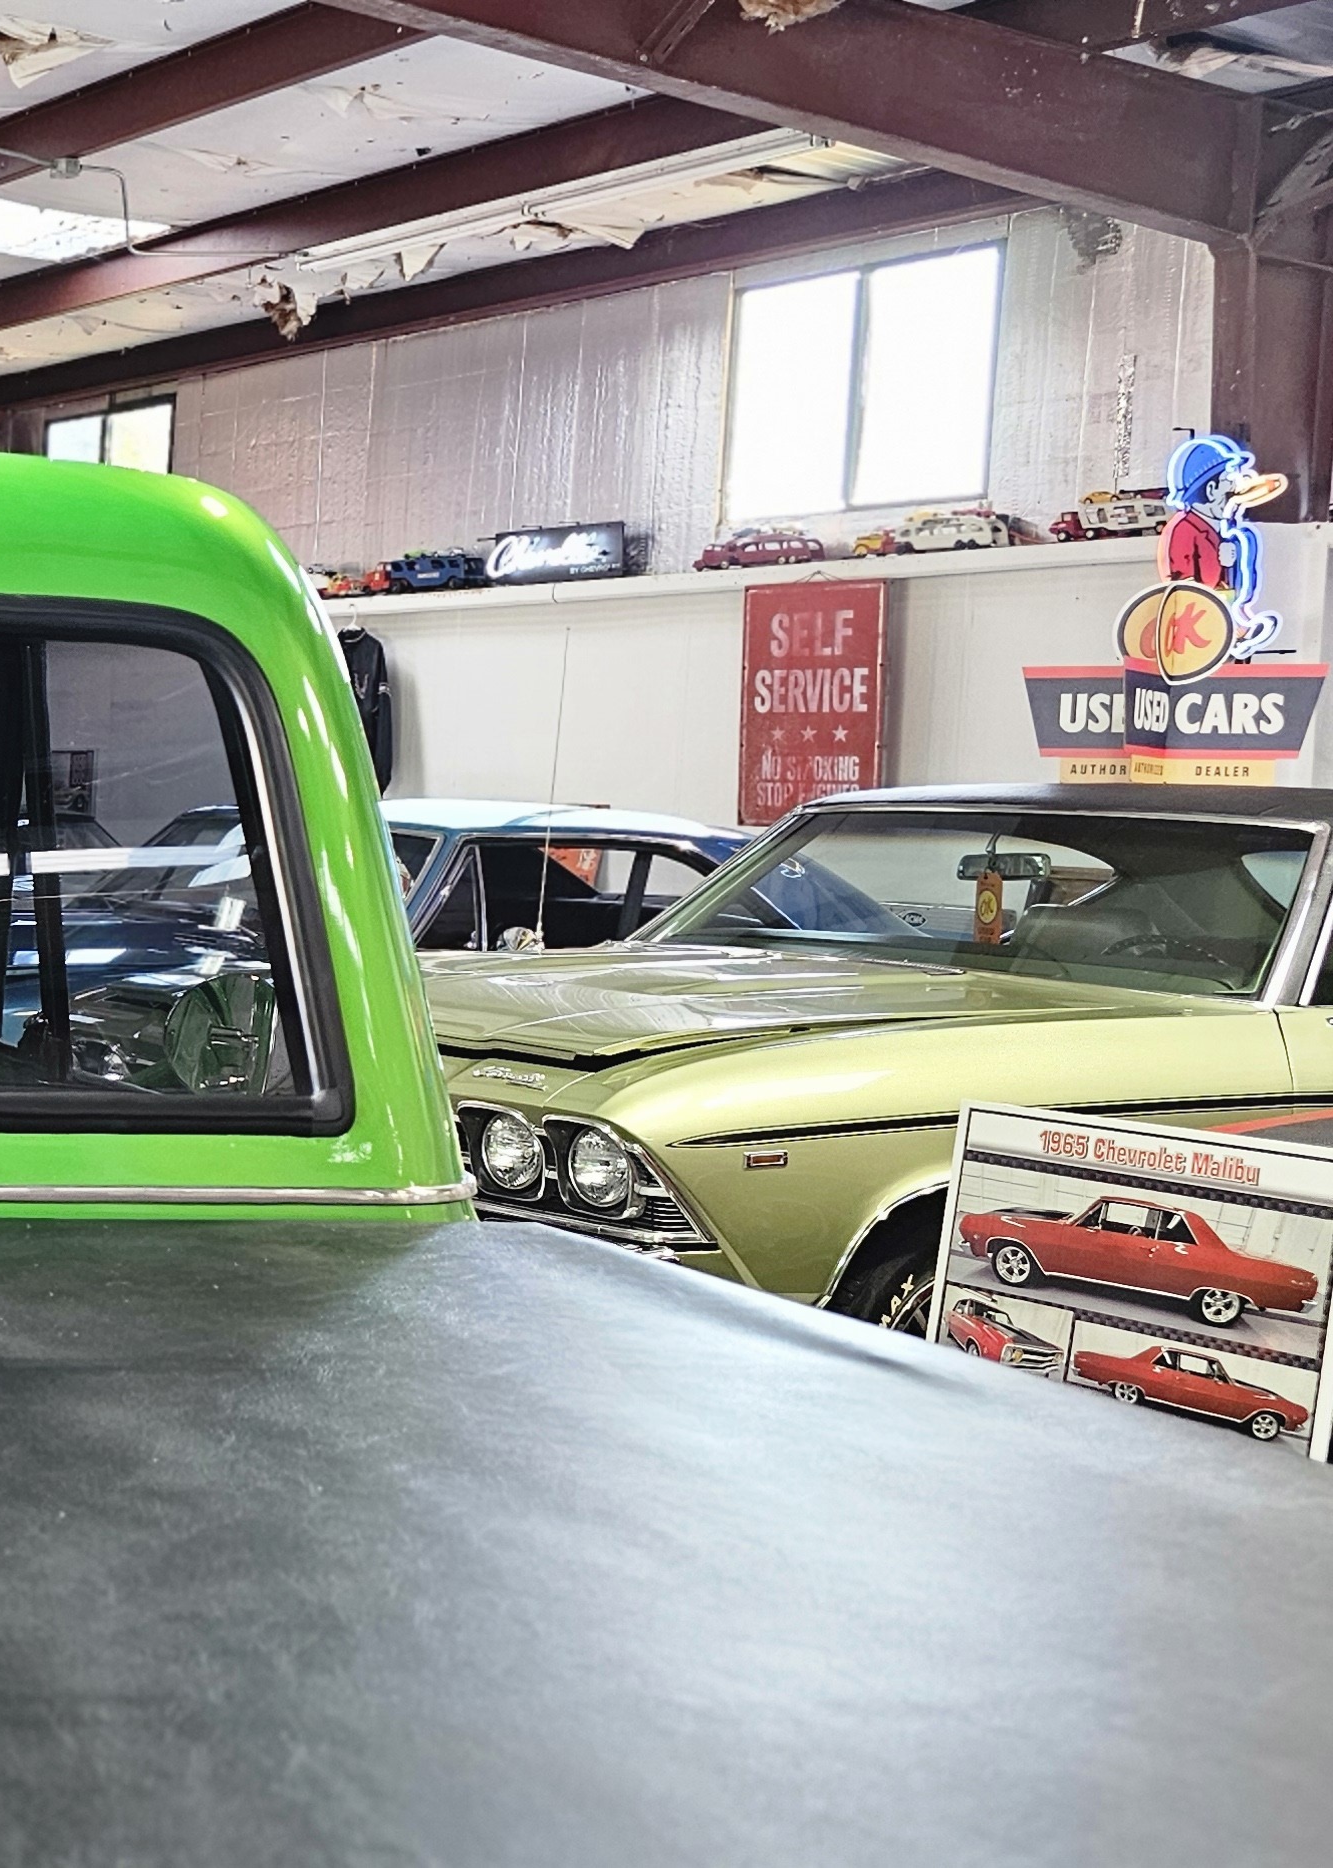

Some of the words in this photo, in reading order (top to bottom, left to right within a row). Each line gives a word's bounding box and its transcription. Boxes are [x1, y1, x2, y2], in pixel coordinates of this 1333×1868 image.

[770, 609, 854, 658] SELF
[754, 667, 869, 714] SERVICE
[1059, 692, 1125, 733] USE
[1133, 688, 1170, 733] USED
[1174, 692, 1285, 735] CARS
[1070, 764, 1128, 776] AUTHOR
[1195, 766, 1250, 777] DEALER
[1039, 1130, 1090, 1159] 1965
[1093, 1138, 1187, 1174] Chevrolet
[1190, 1151, 1261, 1186] Malibu
